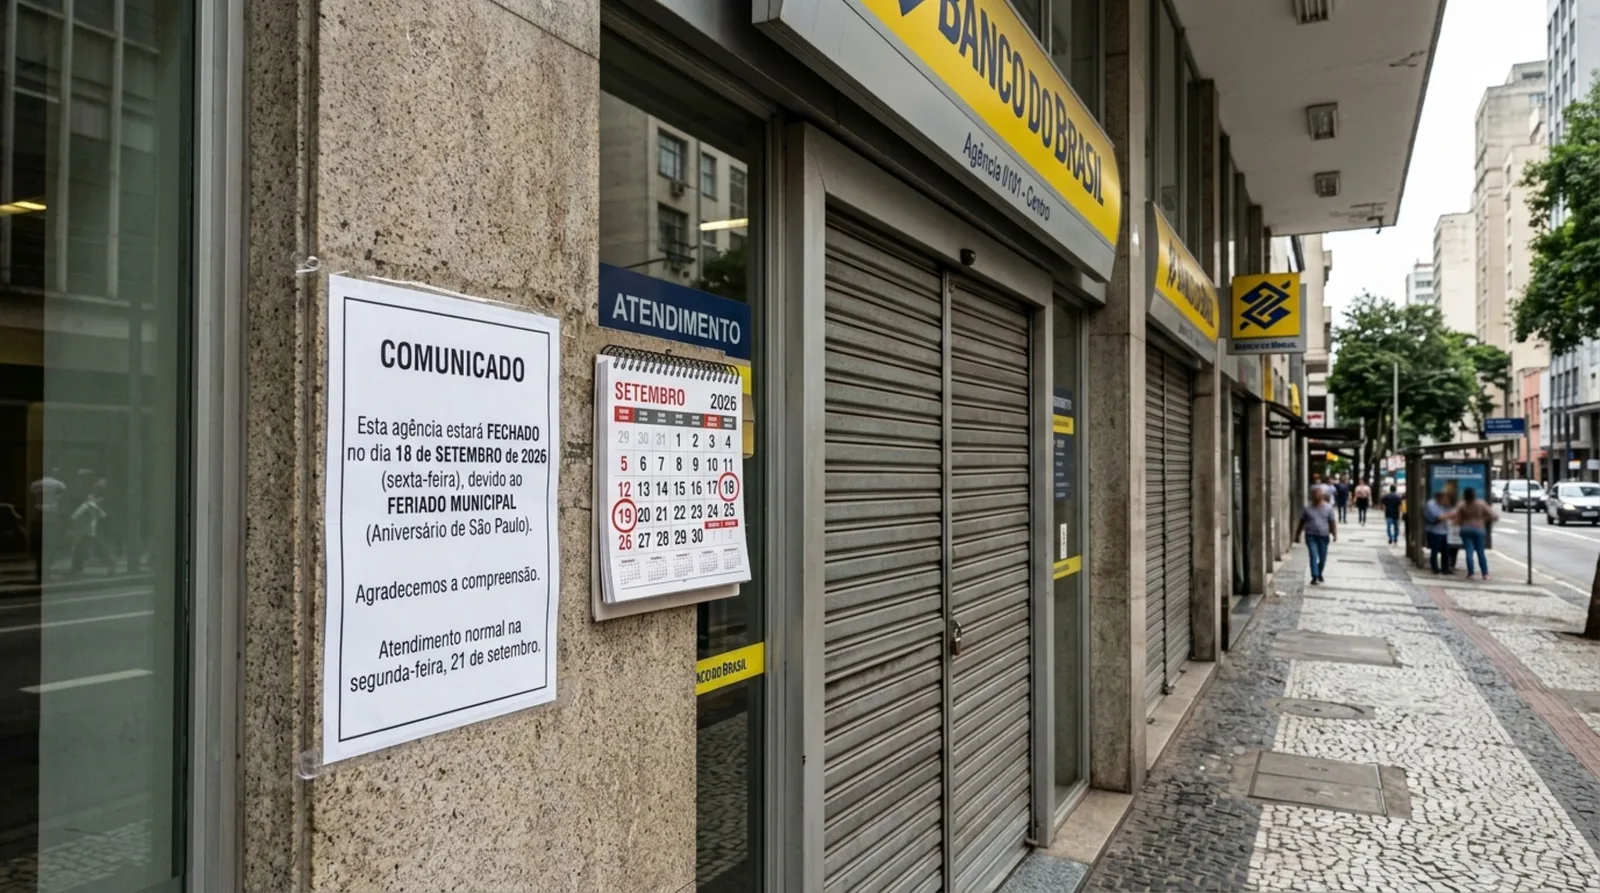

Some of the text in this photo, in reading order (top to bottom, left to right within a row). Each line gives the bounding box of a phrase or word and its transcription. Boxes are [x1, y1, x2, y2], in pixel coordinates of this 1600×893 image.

[1028, 69, 1053, 149] DO
[1054, 91, 1105, 207] BRASIL
[963, 132, 1001, 182] Agência
[612, 292, 741, 345] ATENDIMENTO
[380, 339, 525, 383] COMUNICADO
[615, 381, 737, 412] SETEMBRO 2026
[358, 416, 540, 442] Esta agência estará FECHADO
[618, 430, 731, 448] 29 30 31 1 2 3 4
[347, 444, 547, 464] no dia 18 de SETEMBRO de 2026
[621, 456, 733, 472] 5 6 7 8 9 10 11
[381, 470, 523, 492] (sexta-feira), devido ao
[618, 480, 734, 498] 12 13 14 15 16 17 18
[387, 494, 516, 515] FERIADO MUNICIPAL
[618, 503, 735, 524] 19 20 21 22 23 24 25
[366, 521, 447, 547] (Aniversário
[450, 520, 466, 537] de
[495, 516, 532, 536] Paulo).
[619, 534, 632, 550] 26
[638, 532, 651, 548] 27
[656, 531, 669, 546] 28
[674, 529, 687, 545] 29
[692, 528, 703, 543] 30
[355, 566, 540, 606] Agradecemos a compreensão.
[378, 620, 522, 660] Atendimento normal na
[350, 639, 541, 693] segunda-feira, 21 de setembro.
